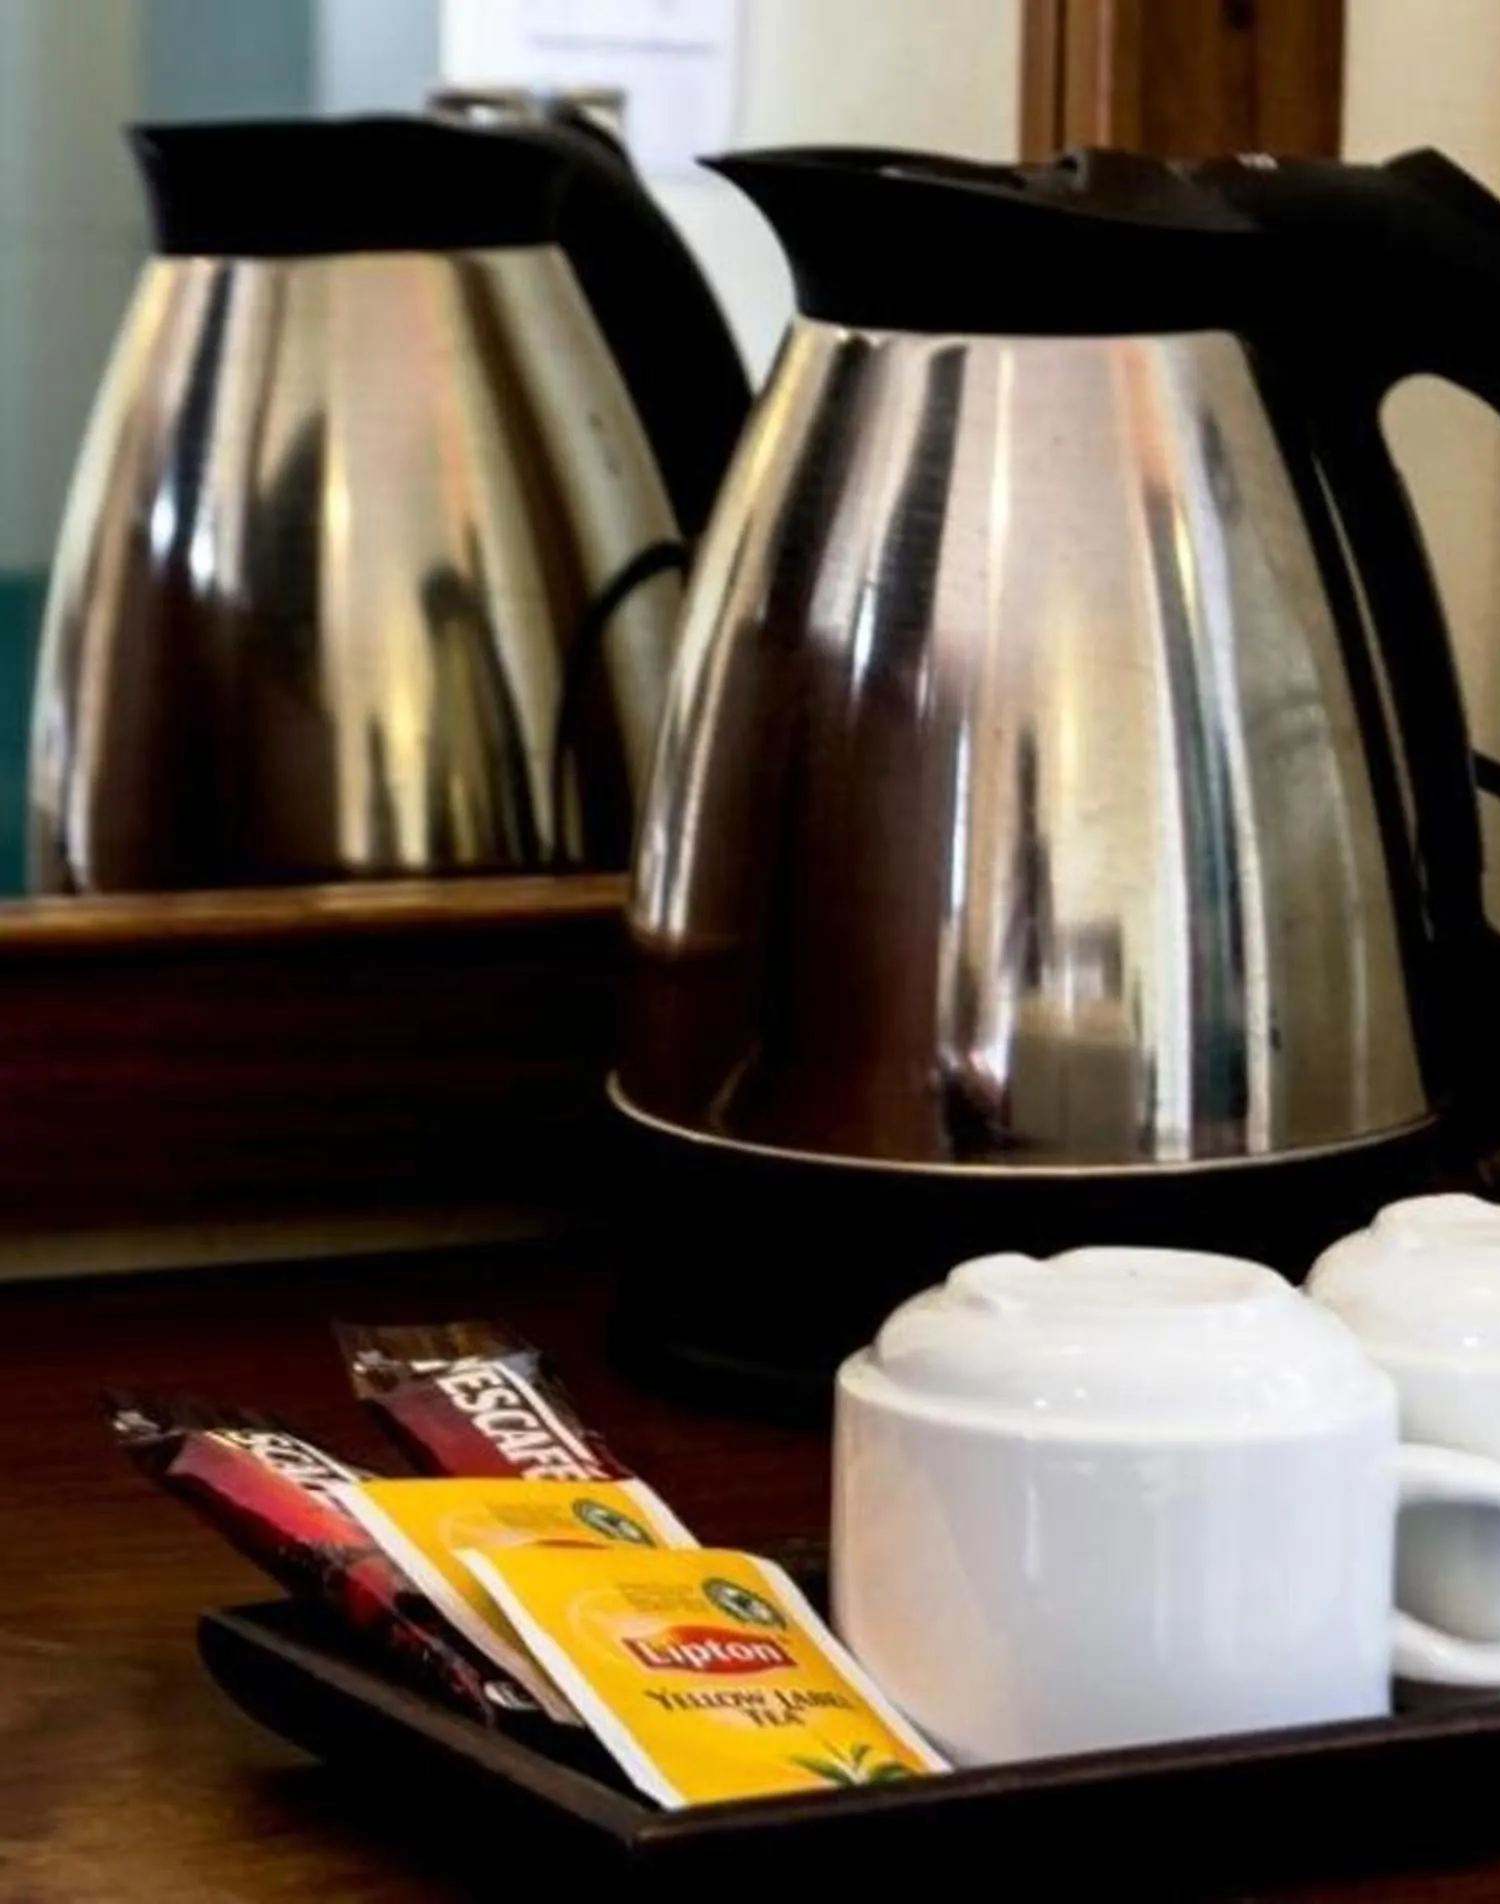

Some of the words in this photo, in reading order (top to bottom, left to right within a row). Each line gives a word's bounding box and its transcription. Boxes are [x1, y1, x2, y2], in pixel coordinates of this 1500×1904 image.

[635, 1636, 783, 1669] Lipton
[643, 1686, 767, 1712] YELLOW
[745, 1707, 807, 1728] TEA
